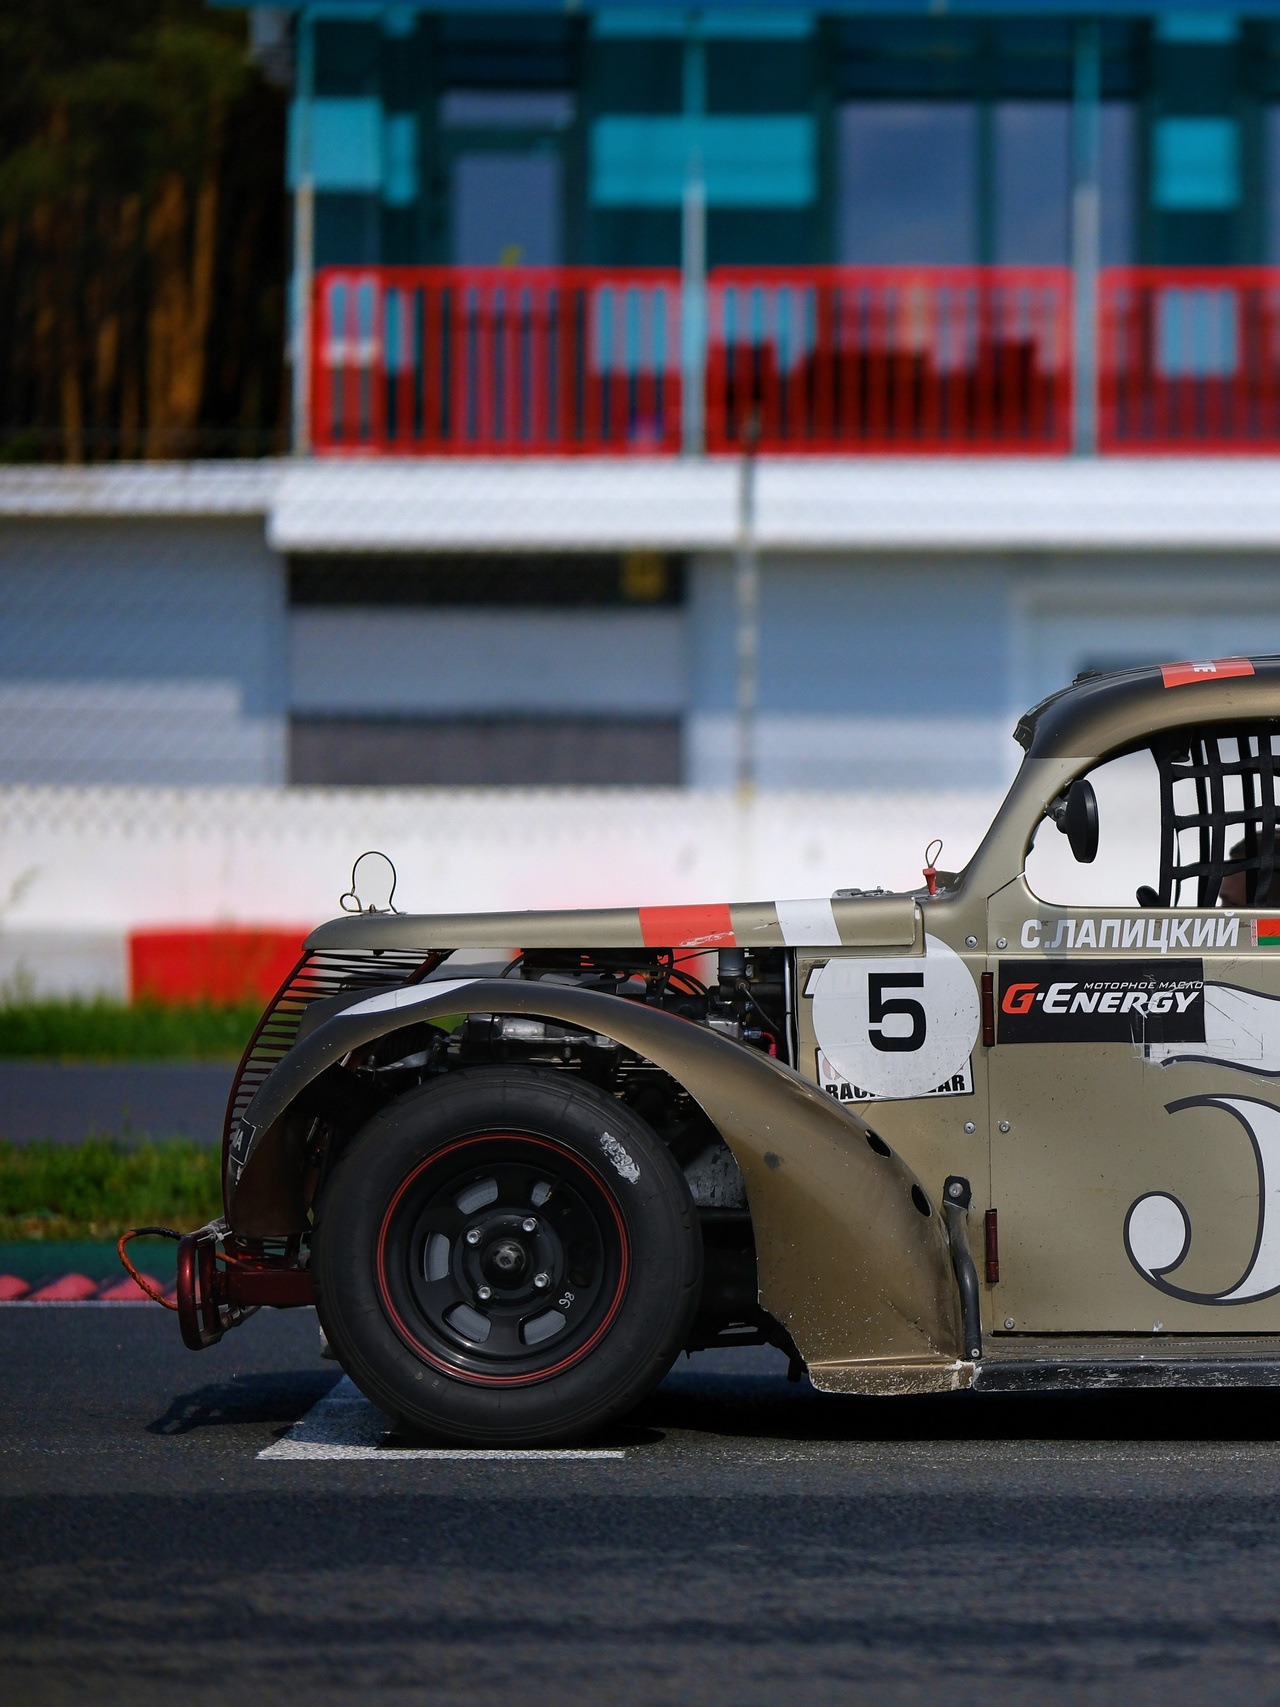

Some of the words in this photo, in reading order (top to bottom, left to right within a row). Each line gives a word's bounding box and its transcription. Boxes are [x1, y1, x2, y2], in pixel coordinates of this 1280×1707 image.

[1083, 982, 1156, 990] МОТОРНОЕ
[868, 972, 927, 1053] 5
[927, 1075, 965, 1094] AR
